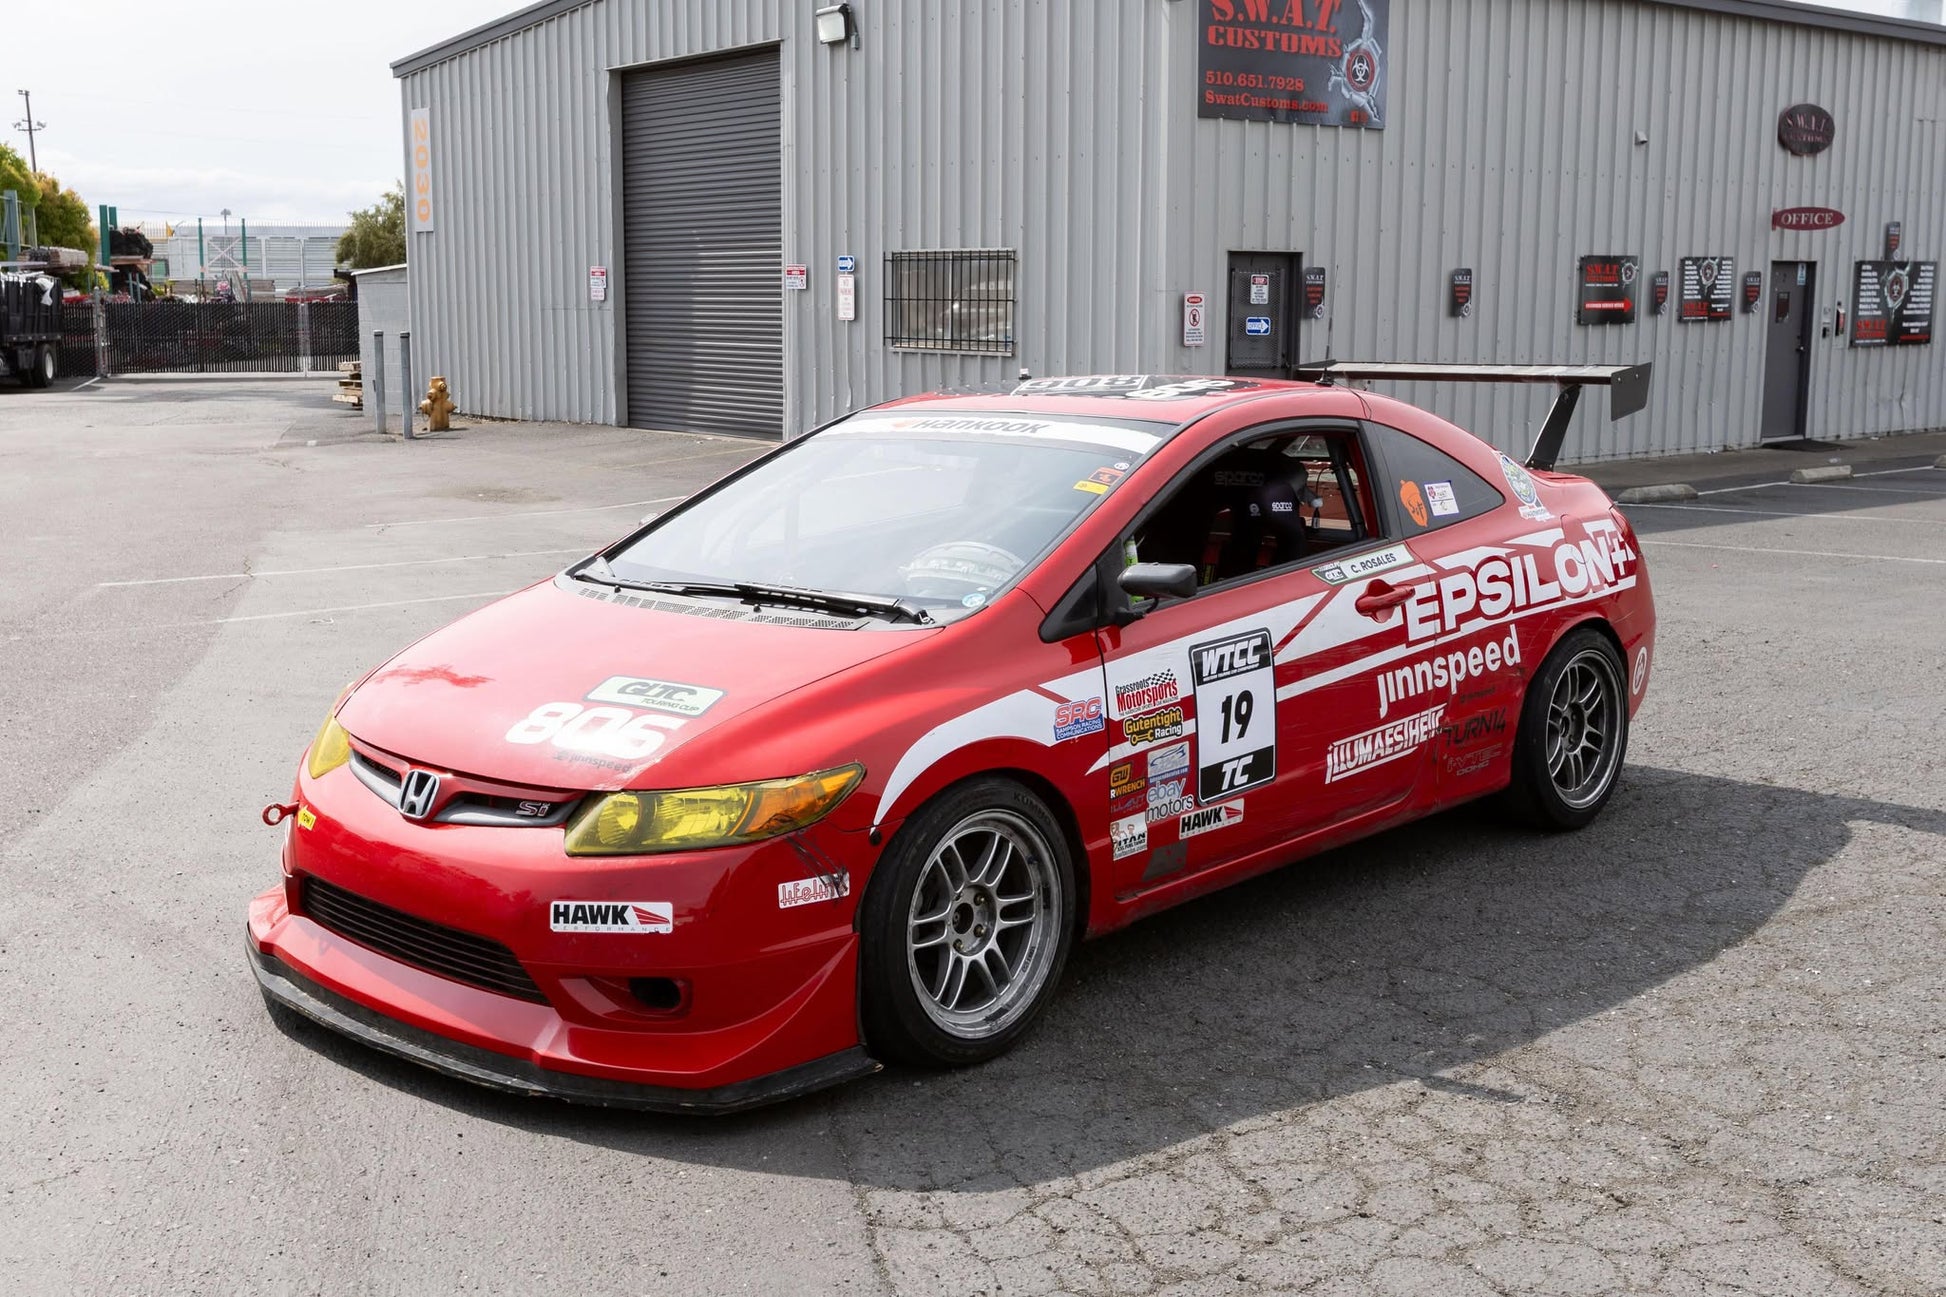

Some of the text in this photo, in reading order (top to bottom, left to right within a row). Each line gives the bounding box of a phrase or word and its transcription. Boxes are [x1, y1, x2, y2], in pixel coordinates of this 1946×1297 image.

[1207, 25, 1342, 57] CUSTOMS
[1205, 71, 1304, 92] 510.651.7928
[1205, 90, 1329, 113] SwatCustoms.com
[414, 119, 430, 222] 2030
[1781, 212, 1833, 225] OFFICE
[1271, 502, 1293, 512] sparco
[1360, 552, 1397, 571] ROSALES
[1202, 637, 1262, 677] WTCC
[1117, 677, 1178, 714] Motorsports
[1056, 698, 1101, 728] SRC
[1125, 710, 1181, 734] Gutentight
[1221, 690, 1254, 745] 19
[505, 702, 690, 760] 806
[1155, 725, 1182, 739] Racing
[1221, 754, 1254, 791] TC
[515, 801, 551, 817] Si
[1146, 795, 1193, 823] motors
[1181, 806, 1224, 834] HAWK
[553, 904, 630, 925] HAWK
